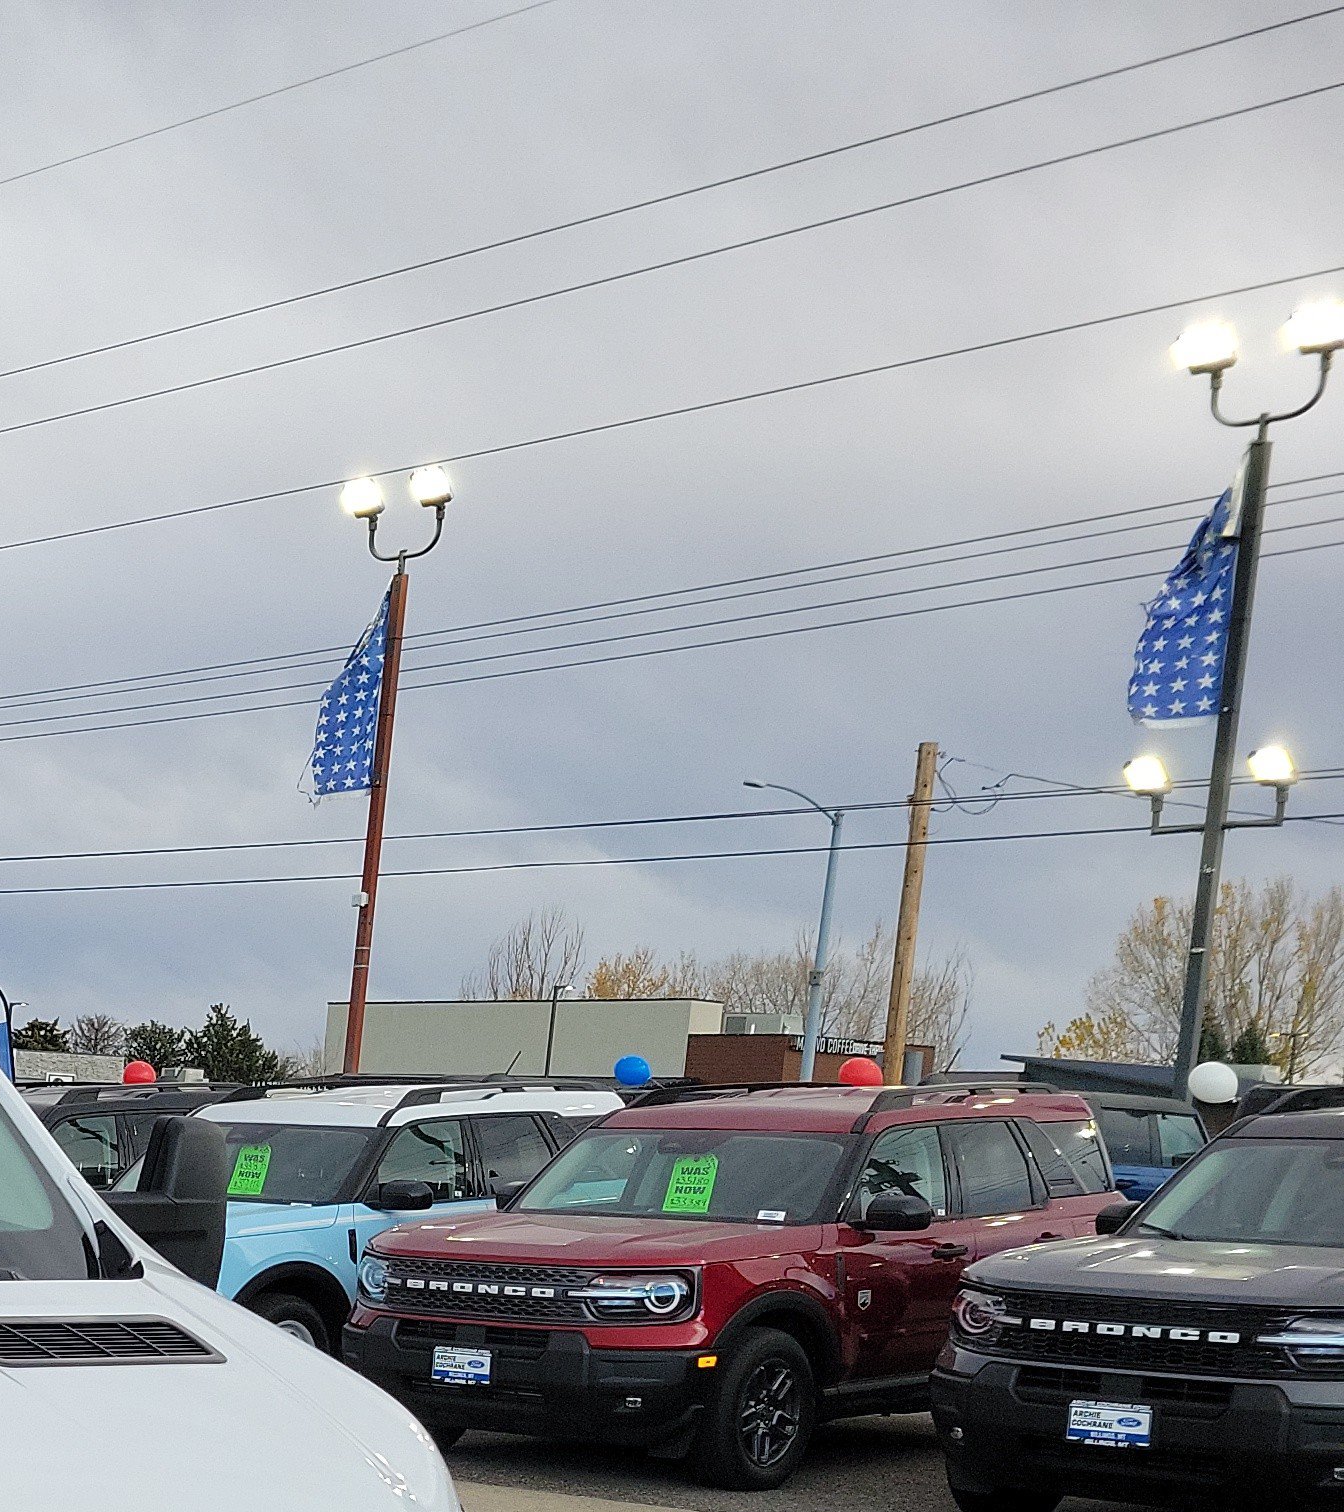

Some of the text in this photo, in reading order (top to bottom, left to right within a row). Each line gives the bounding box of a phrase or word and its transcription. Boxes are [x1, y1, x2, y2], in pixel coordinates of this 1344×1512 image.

[796, 1036, 854, 1055] MVO COFFEE
[681, 1166, 710, 1176] WAS
[674, 1186, 707, 1195] NOW
[406, 1279, 555, 1298] BRONCO
[1029, 1318, 1240, 1344] BRONCO
[1073, 1410, 1101, 1418] ARCHIE
[1072, 1419, 1114, 1429] COCHRANE
